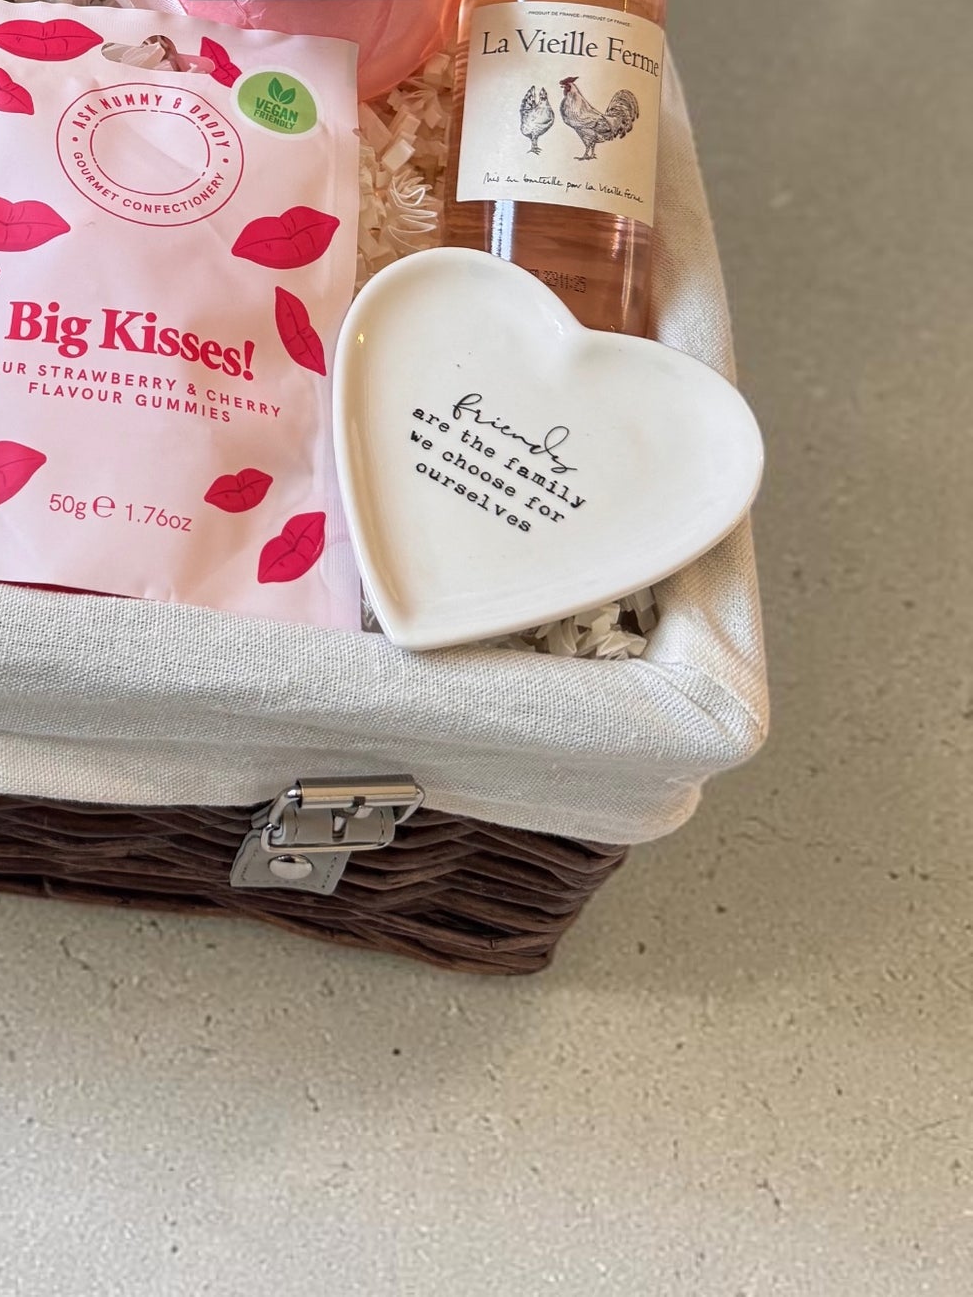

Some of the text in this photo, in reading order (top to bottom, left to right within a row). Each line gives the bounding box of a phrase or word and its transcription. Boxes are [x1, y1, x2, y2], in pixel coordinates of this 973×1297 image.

[482, 29, 659, 77] La Vieille Ferme
[72, 104, 99, 130] ASK
[189, 104, 231, 149] DADDY
[253, 109, 296, 130] FRIENDLY
[255, 97, 299, 123] VEGAN
[73, 151, 225, 214] GOURMET CONFECTIONERY
[4, 301, 255, 381] Big Kisses!
[28, 382, 231, 422] FLAVOUR GUMMIES
[38, 364, 177, 391] STRAWBERRY
[187, 383, 197, 396] &
[206, 389, 281, 417] CHERRY
[412, 407, 586, 509] are the family
[452, 393, 577, 473] friends
[410, 430, 565, 523] we choose for
[415, 462, 532, 532] ourselves
[49, 493, 87, 520] 50g
[125, 504, 193, 532] 1.76oz
